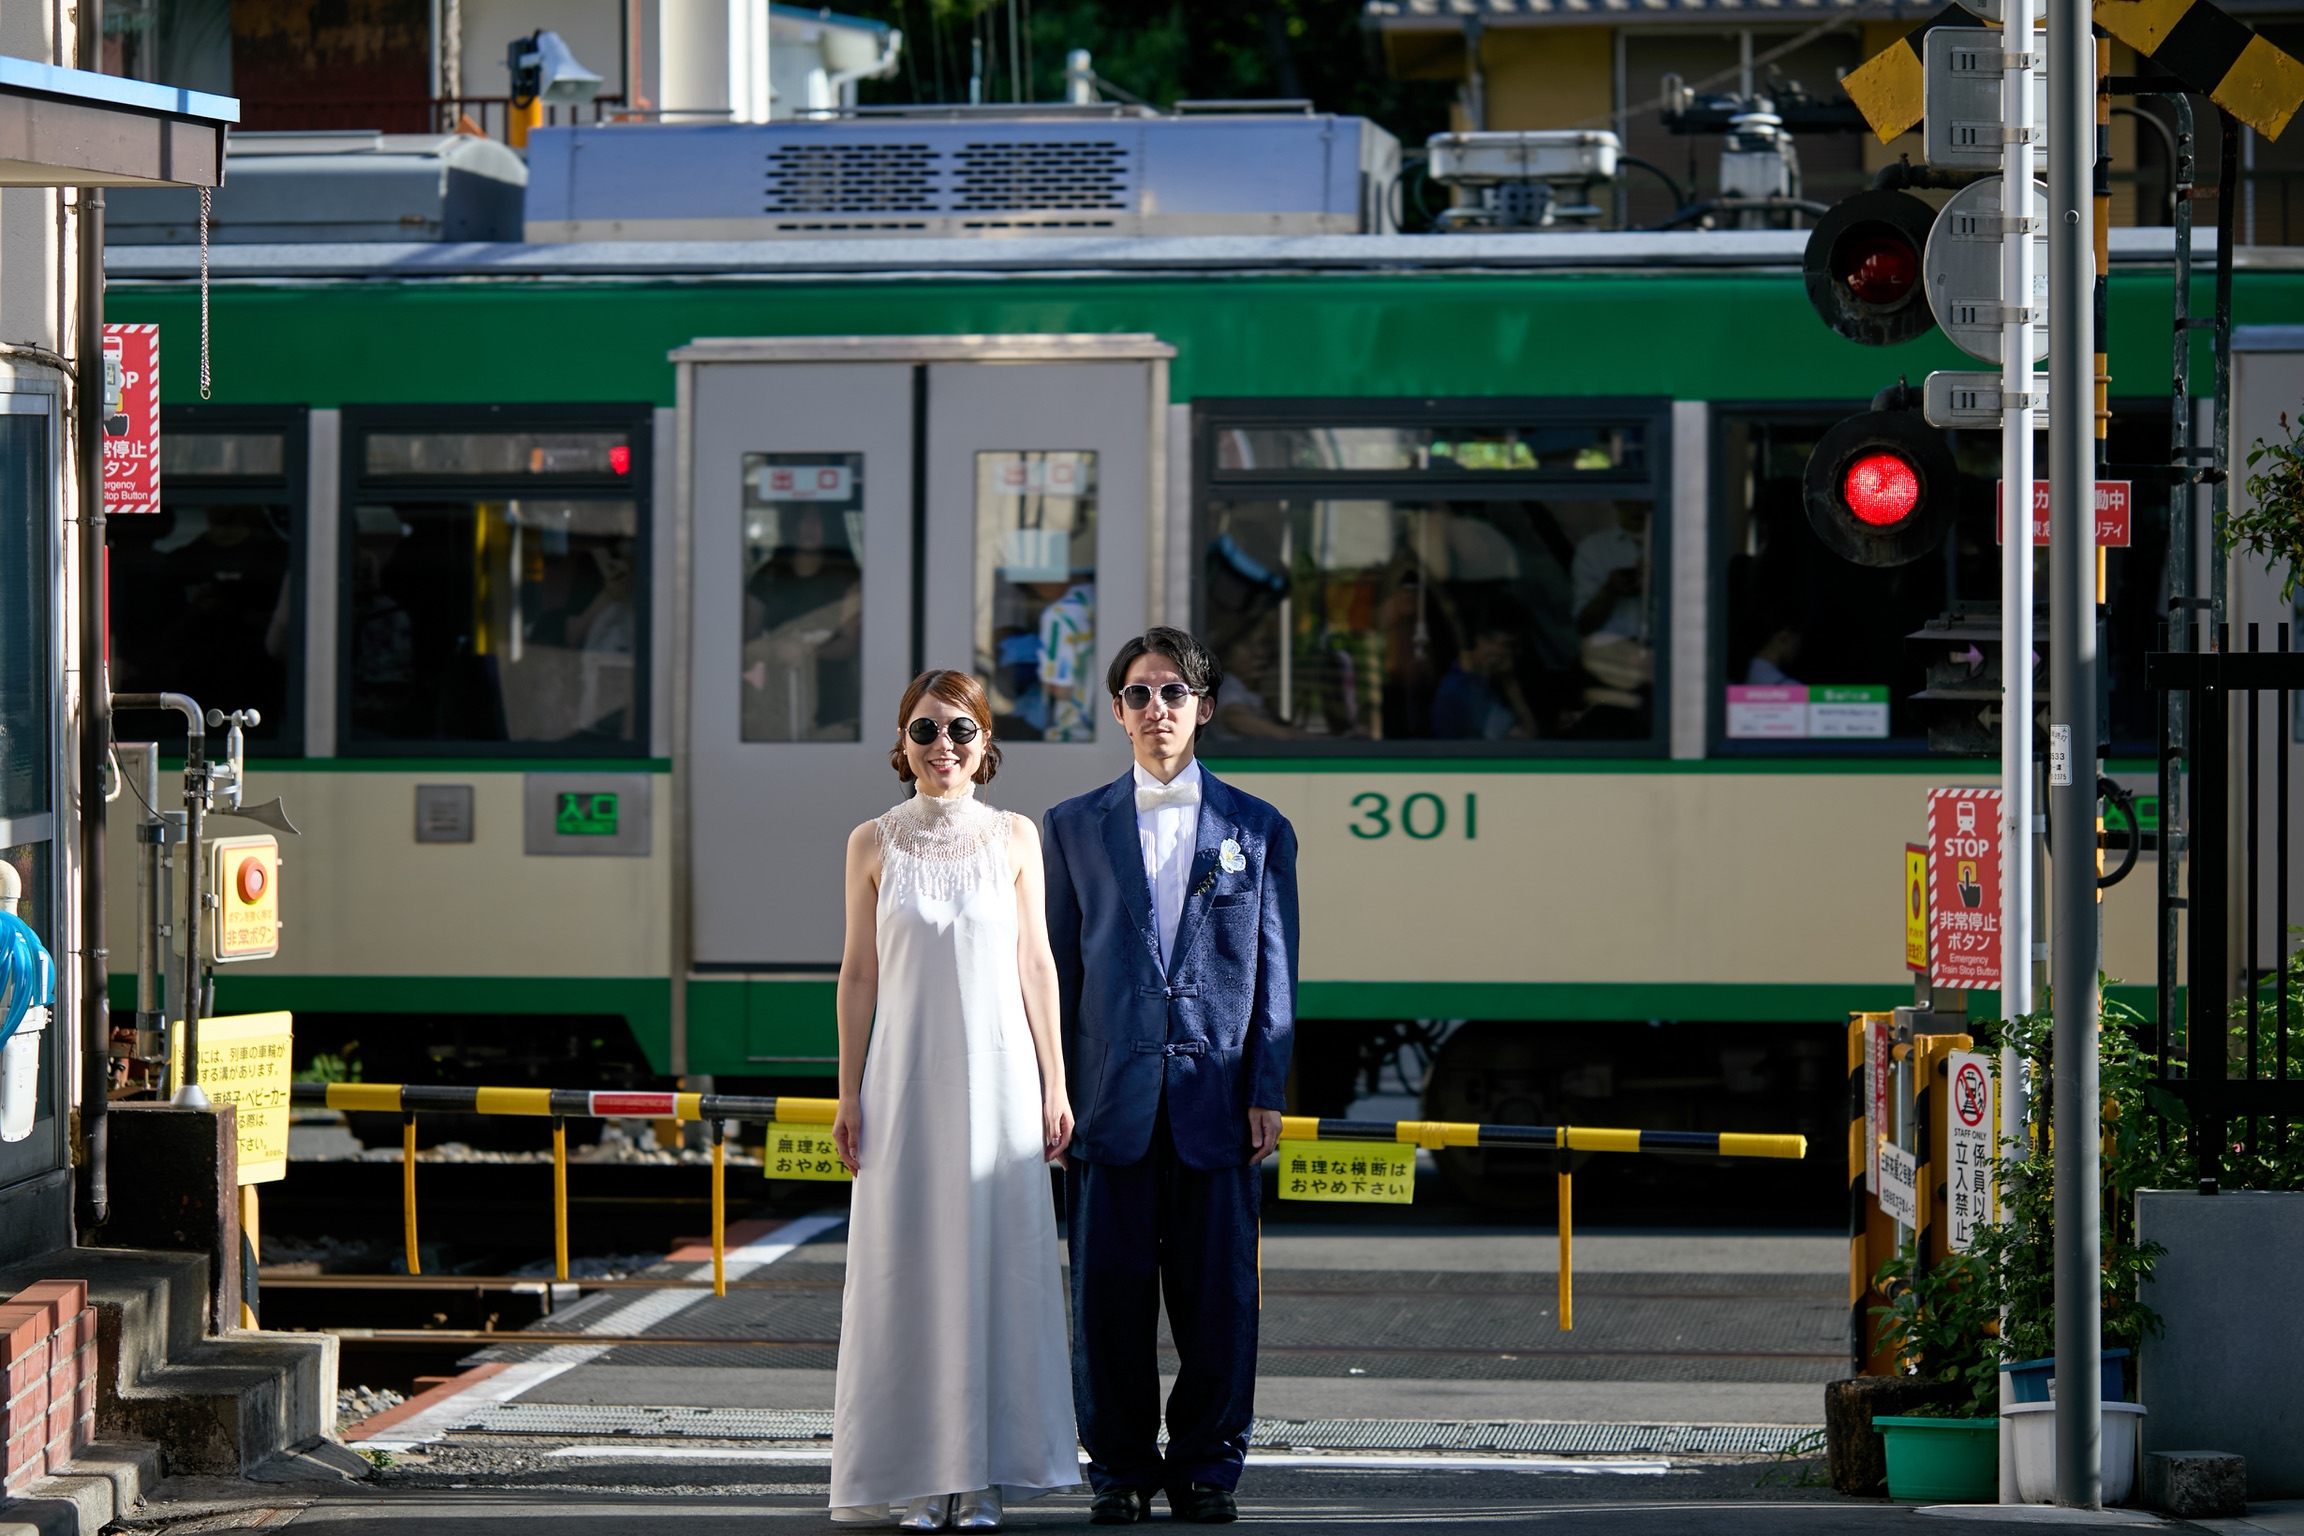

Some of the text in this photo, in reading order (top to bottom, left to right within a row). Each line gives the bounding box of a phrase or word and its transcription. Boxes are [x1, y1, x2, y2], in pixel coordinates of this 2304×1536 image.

[121, 491, 148, 500] Button
[557, 793, 618, 821] 入口
[1349, 792, 1476, 840] 301
[1944, 838, 1990, 858] STOP
[1939, 911, 1998, 932] 非常停止
[226, 926, 276, 947] 非常ボタン
[1948, 932, 1991, 951] ボタン
[1950, 953, 1989, 967] Emergency
[1941, 964, 1999, 976] Train Stop Button
[1954, 1128, 1987, 1140] STAFF ONLY
[1291, 1159, 1407, 1177] 無理な横断は
[1290, 1178, 1405, 1195] おやめ下さい
[1955, 1140, 1969, 1243] 立入禁止
